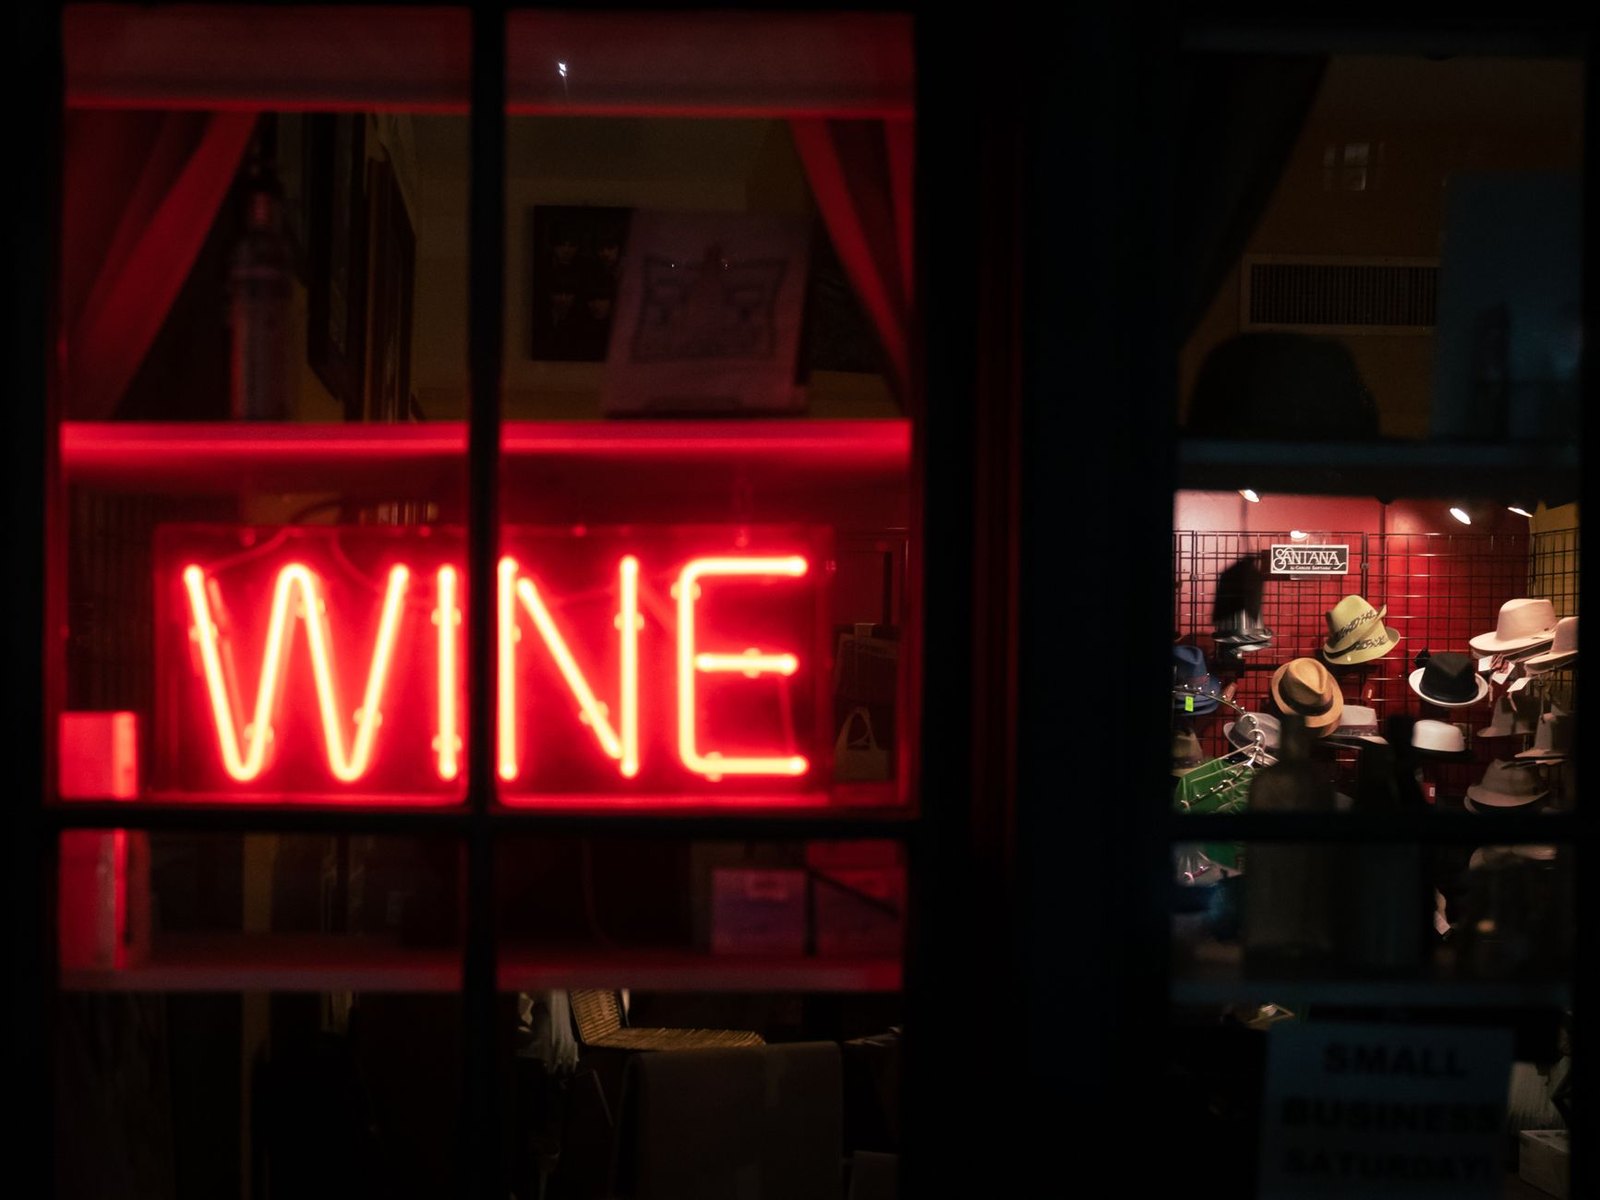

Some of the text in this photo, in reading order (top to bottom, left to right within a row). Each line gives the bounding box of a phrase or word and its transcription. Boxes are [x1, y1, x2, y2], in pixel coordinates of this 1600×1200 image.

[1273, 547, 1346, 570] SANTANA
[183, 553, 810, 783] WINE
[1324, 1042, 1467, 1077] SMALL
[1282, 1098, 1500, 1133] BUSINESS
